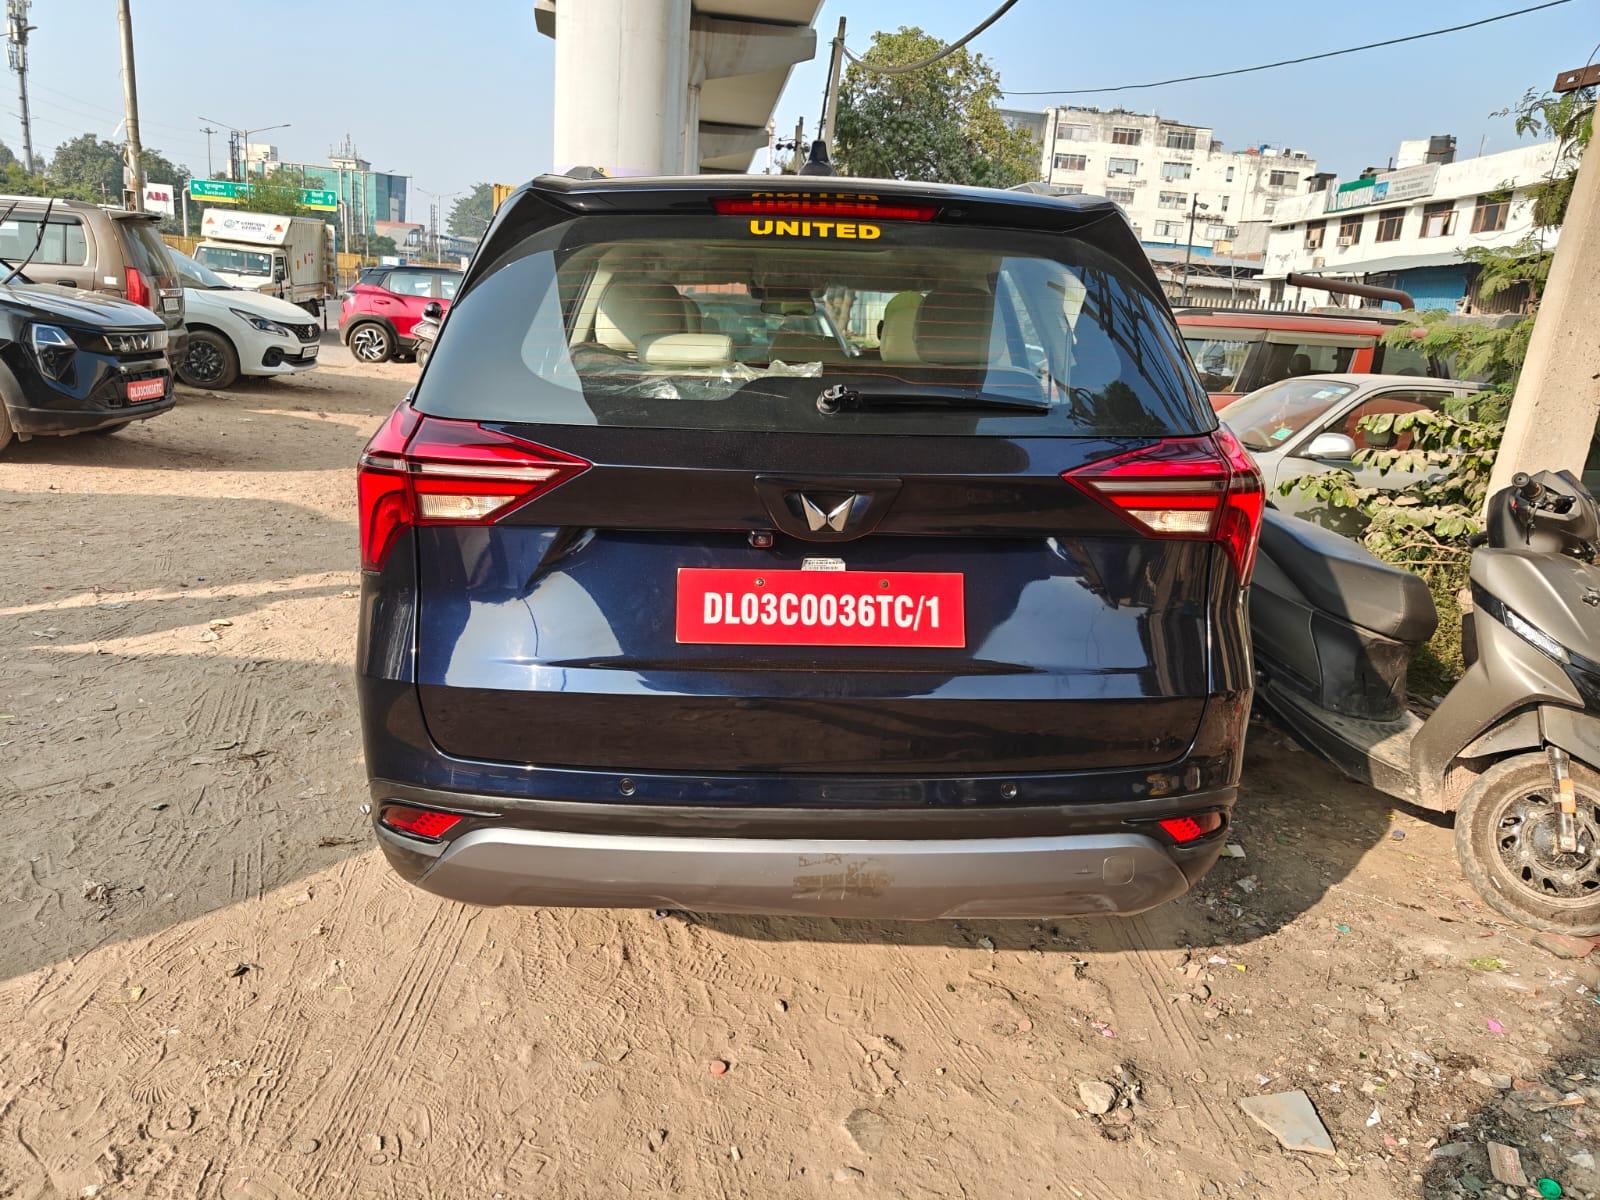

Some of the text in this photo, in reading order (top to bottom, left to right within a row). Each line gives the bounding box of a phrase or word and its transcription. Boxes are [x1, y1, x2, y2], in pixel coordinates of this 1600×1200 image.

[146, 191, 169, 202] ABB
[750, 220, 881, 240] UNITED
[703, 592, 940, 632] DL03C0036TC/1
